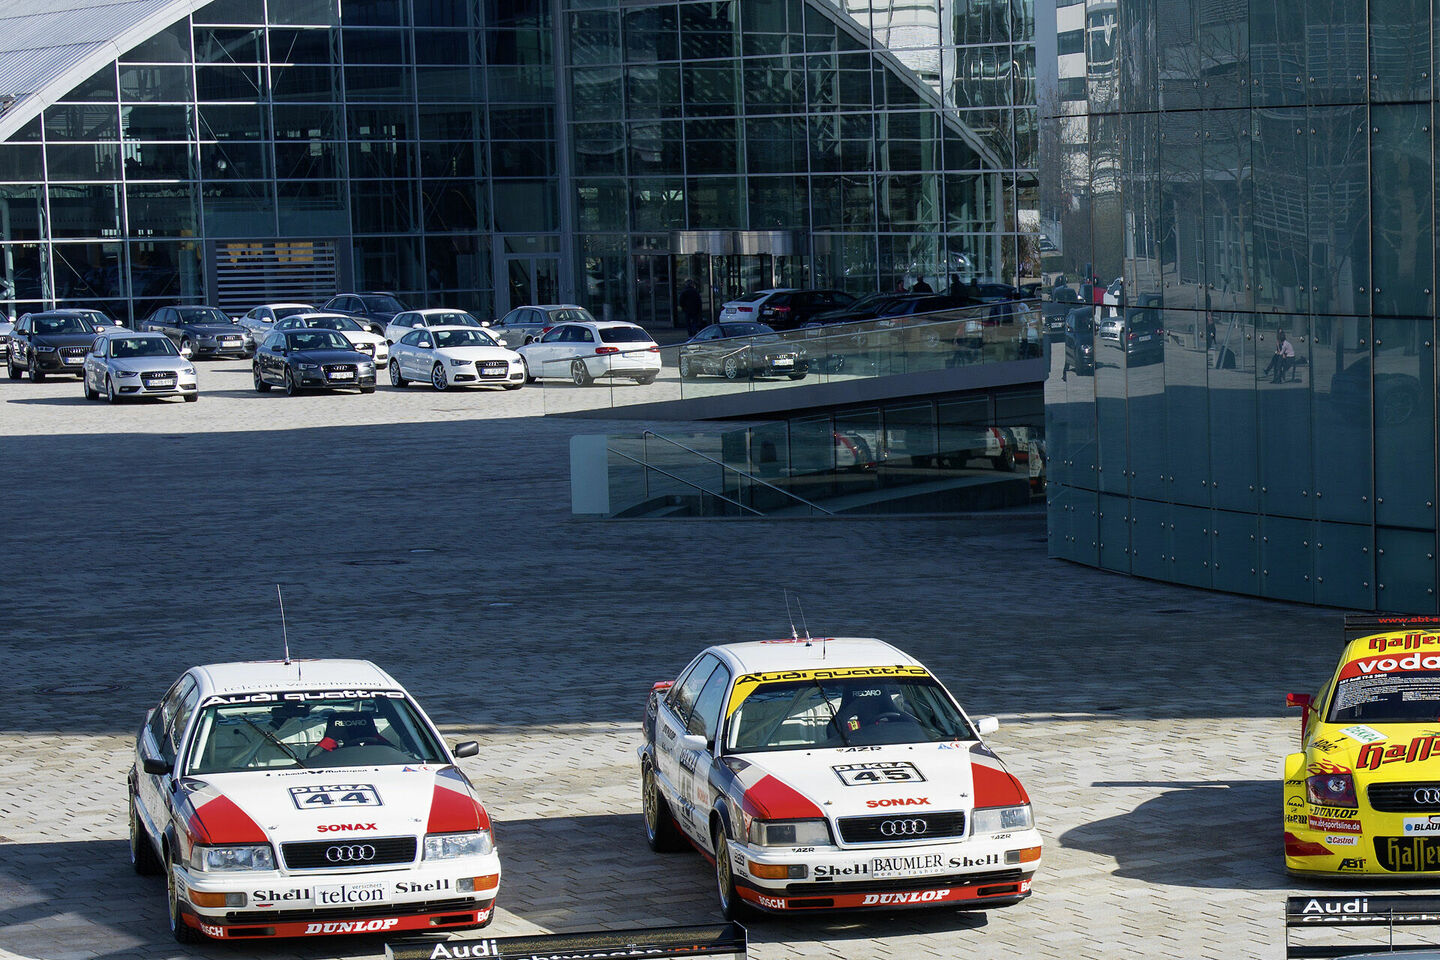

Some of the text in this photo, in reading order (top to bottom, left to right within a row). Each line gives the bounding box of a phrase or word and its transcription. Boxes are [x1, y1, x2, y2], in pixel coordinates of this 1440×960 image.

[737, 667, 926, 685] Audi quattro
[202, 690, 405, 707] Audi quattro
[837, 761, 914, 772] DEKRA
[853, 769, 912, 782] 45
[291, 784, 373, 793] DEKRA
[305, 792, 369, 806] 44
[866, 797, 931, 808] SONAX
[1313, 807, 1359, 818] DUNLOP
[317, 822, 378, 833] SONAX
[1332, 836, 1354, 844] Castrol
[949, 854, 998, 867] Shell
[814, 863, 867, 876] Shell
[395, 879, 449, 895] Shell
[253, 888, 310, 901] Shell
[321, 886, 384, 904] telcon
[862, 889, 950, 905] DUNLOP
[1302, 898, 1369, 914] Audi
[305, 918, 399, 934] DUNLOP
[430, 939, 499, 960] Audi
